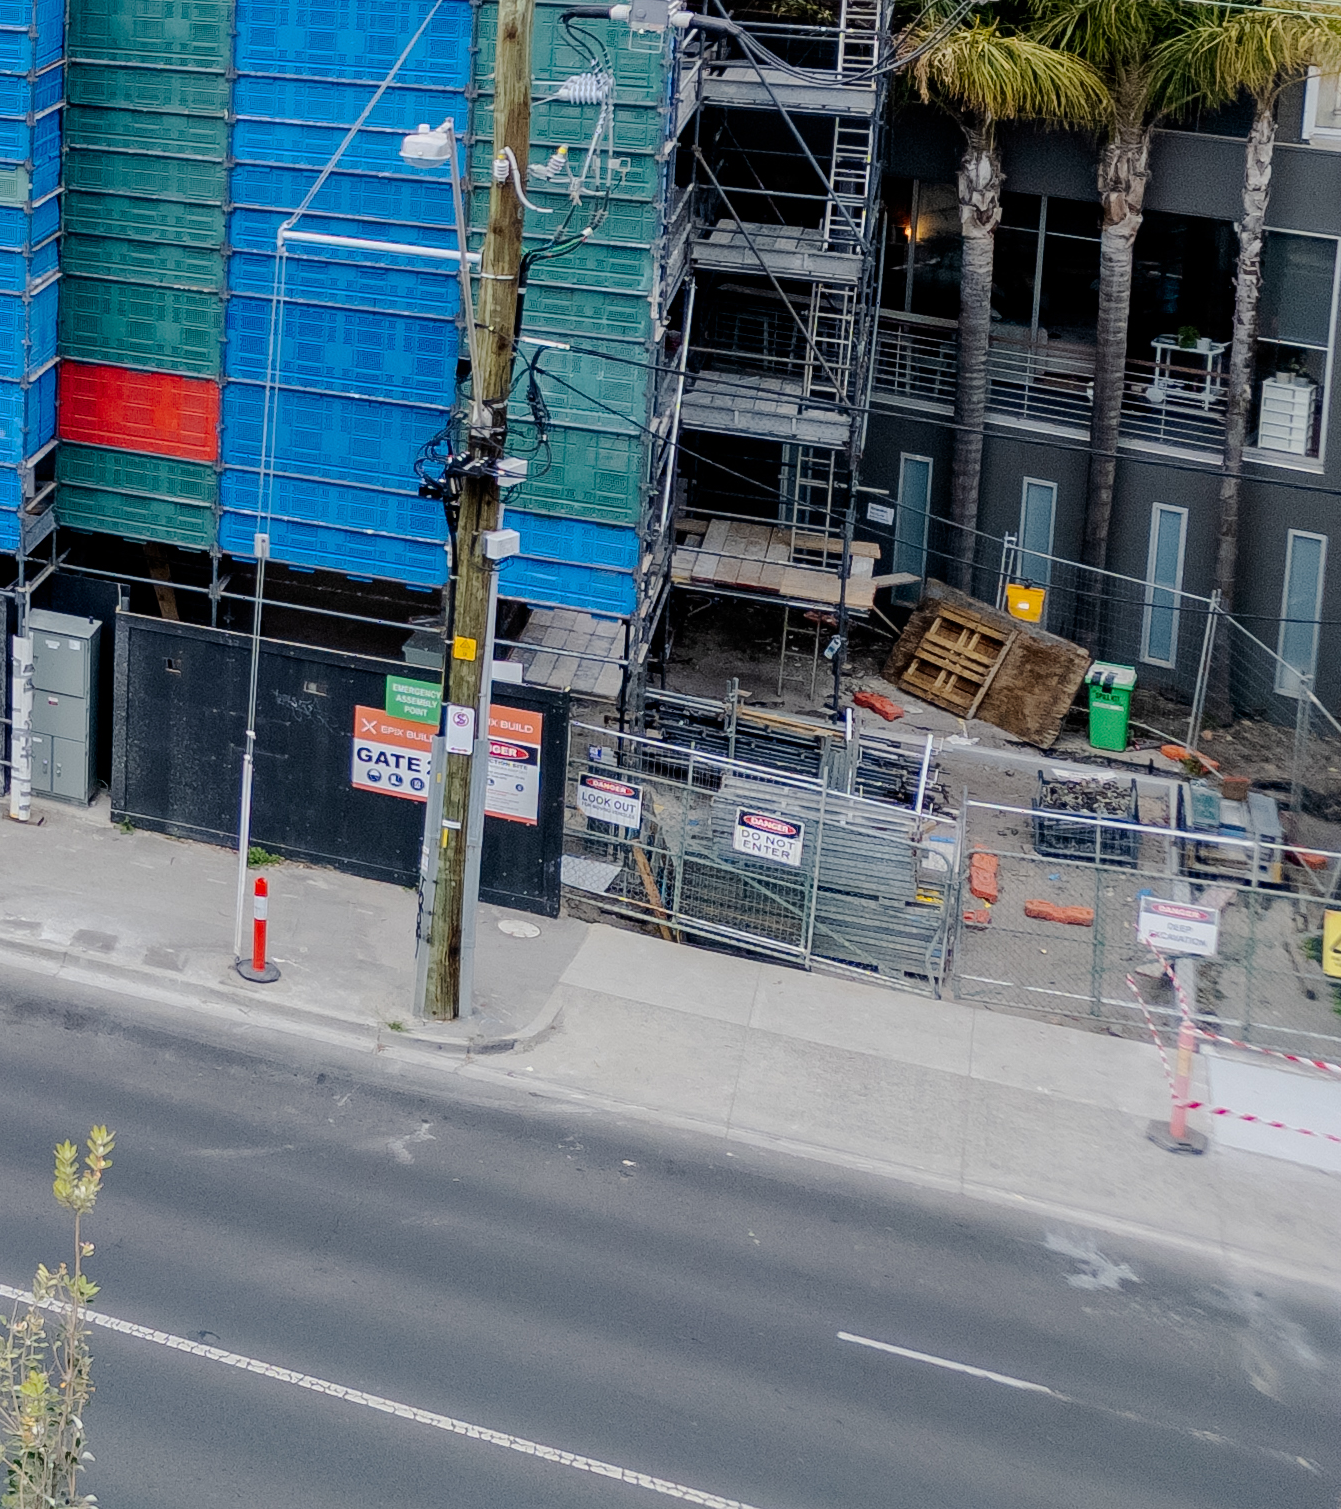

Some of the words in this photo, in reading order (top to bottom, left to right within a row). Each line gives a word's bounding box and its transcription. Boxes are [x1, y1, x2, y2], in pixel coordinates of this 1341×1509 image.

[392, 682, 442, 699] EMERGENCY
[395, 694, 438, 708] ASSEMBLY
[404, 705, 428, 717] POINT
[380, 725, 404, 737] EPIX
[500, 720, 533, 734] BUILD
[488, 743, 518, 758] GER
[356, 746, 423, 773] GATE
[581, 792, 611, 807] LOOK
[614, 800, 636, 813] OUT
[750, 816, 789, 833] DANGER
[741, 829, 761, 841] DO
[765, 835, 796, 851] NOT
[743, 839, 791, 860] ENTER
